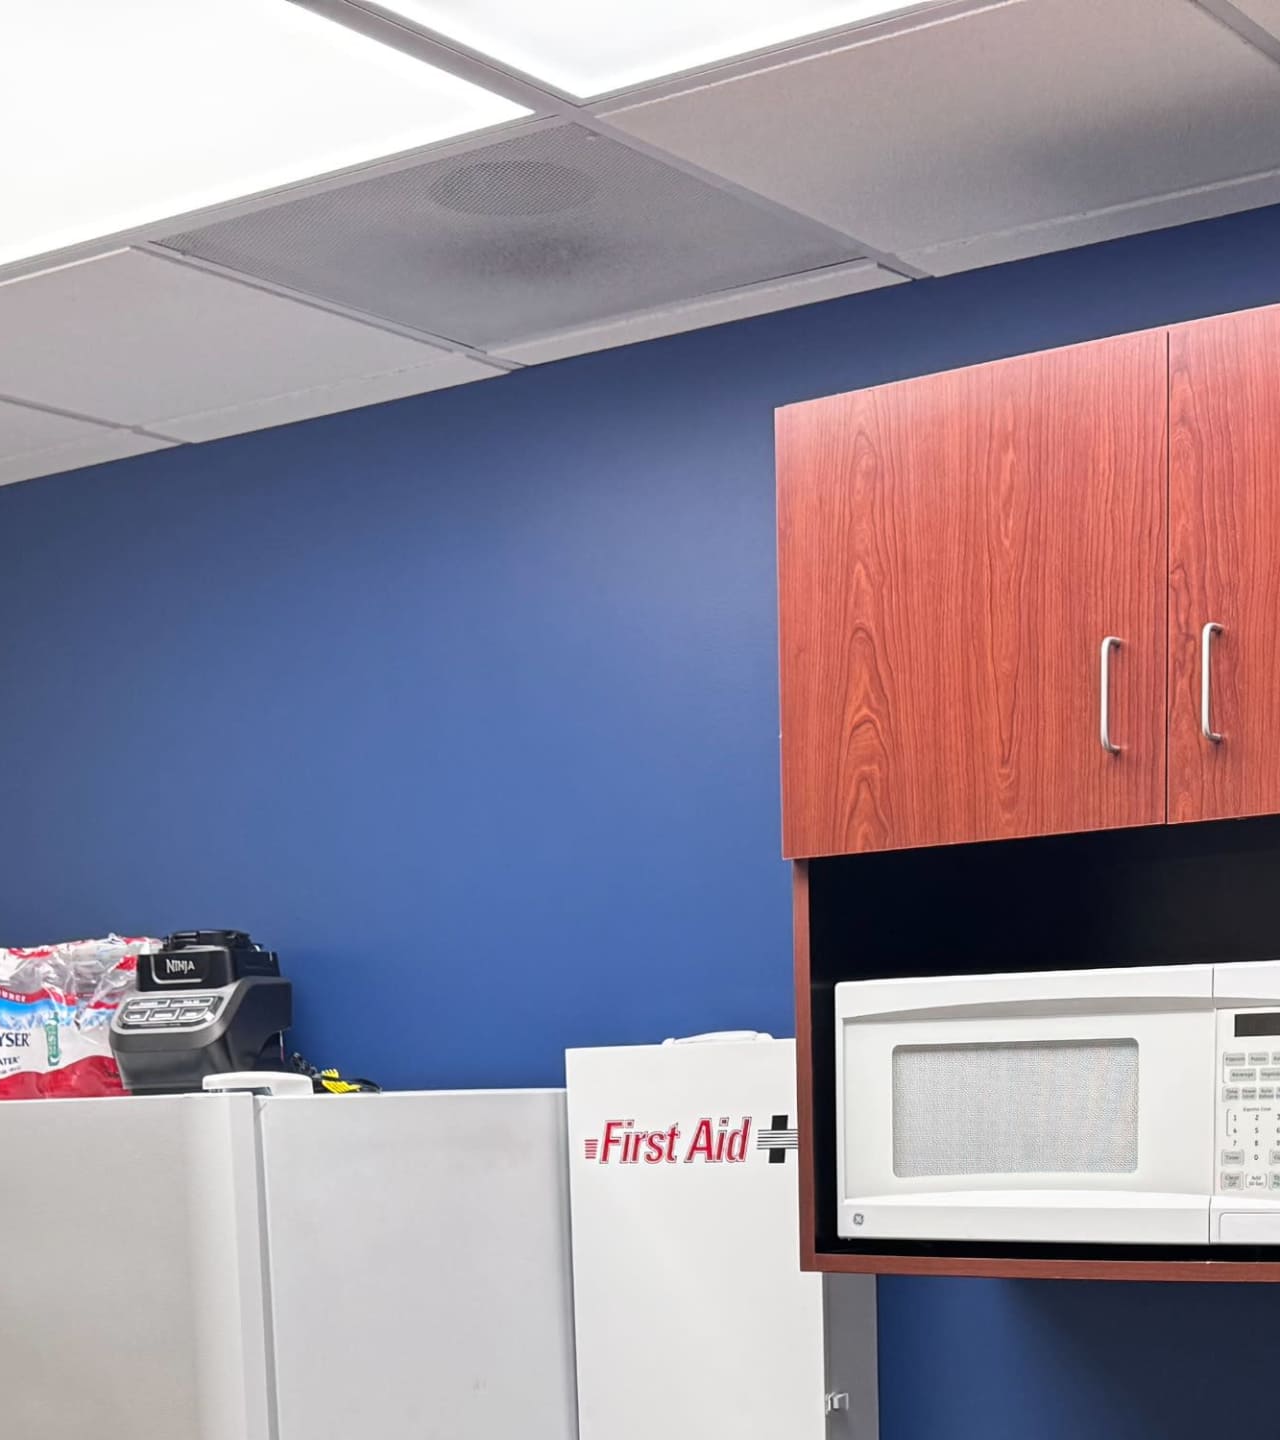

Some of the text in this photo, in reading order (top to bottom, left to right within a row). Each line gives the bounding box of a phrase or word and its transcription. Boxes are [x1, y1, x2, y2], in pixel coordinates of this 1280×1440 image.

[166, 959, 195, 974] NINJA
[600, 1116, 752, 1164] First Aid
